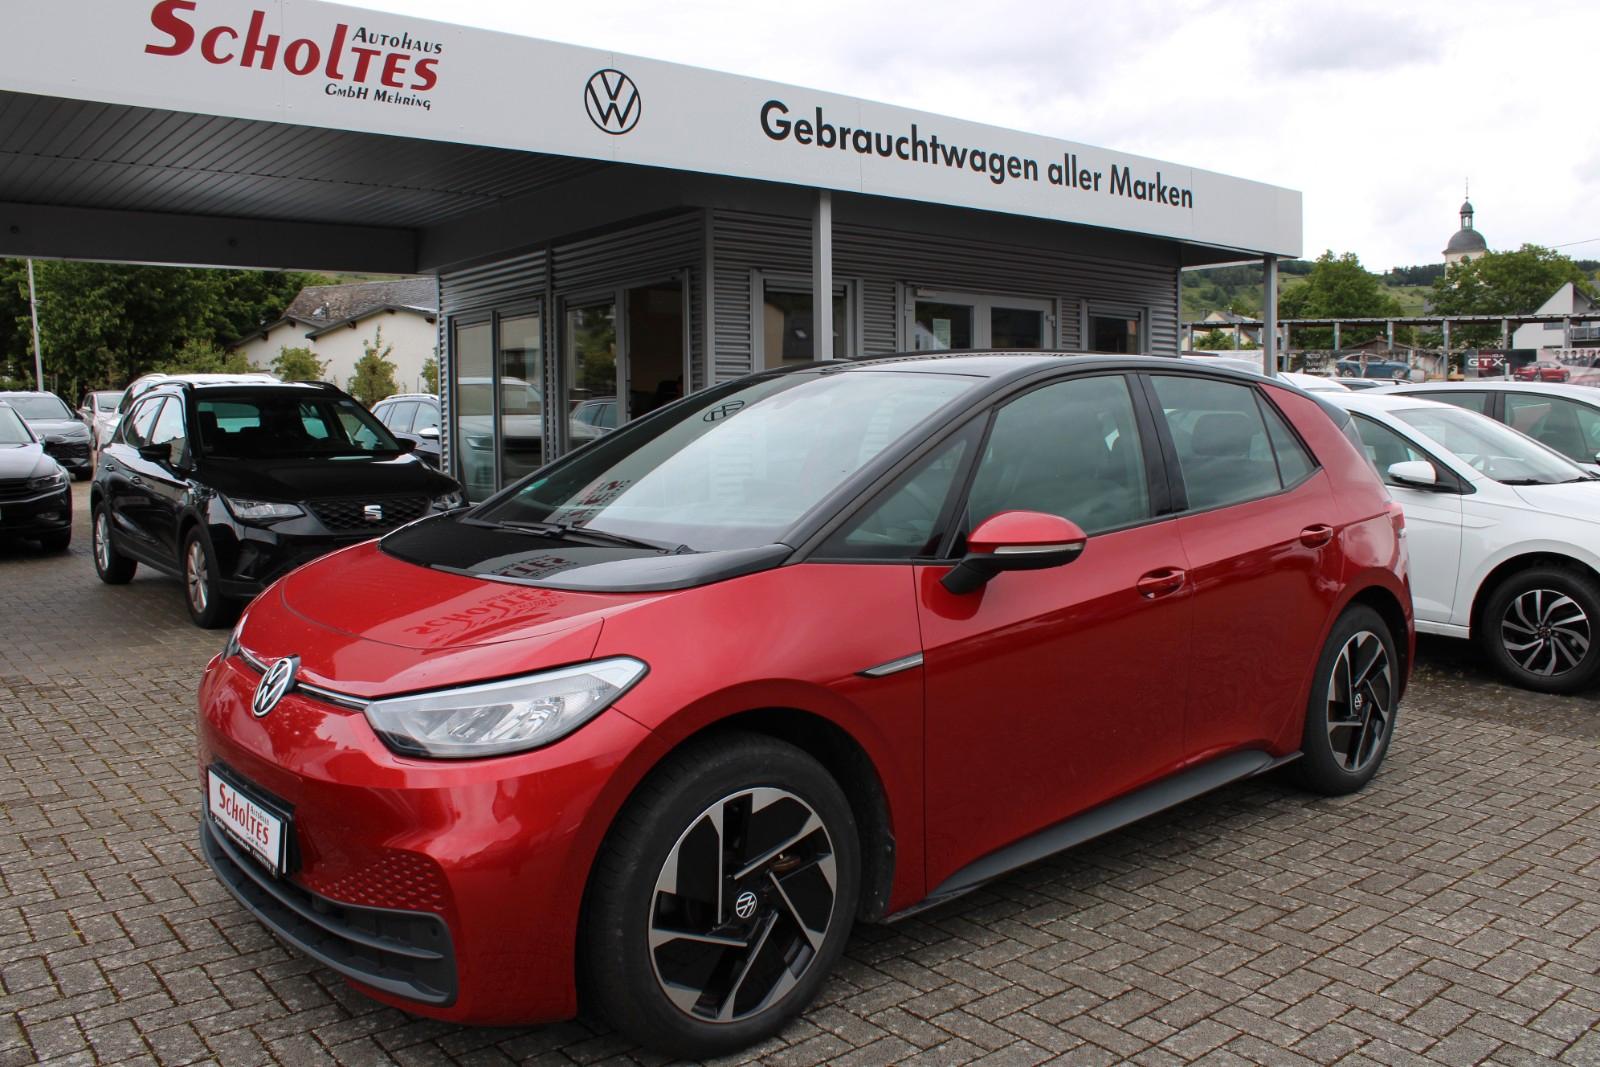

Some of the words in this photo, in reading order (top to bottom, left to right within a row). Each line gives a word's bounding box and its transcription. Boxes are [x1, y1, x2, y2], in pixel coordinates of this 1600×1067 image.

[325, 83, 369, 100] GmbH
[373, 89, 432, 111] Mehring
[760, 99, 1038, 185] Gebrauchtwagen
[1048, 153, 1101, 192] aller
[1109, 164, 1193, 208] Marken
[1467, 358, 1503, 367] GTX
